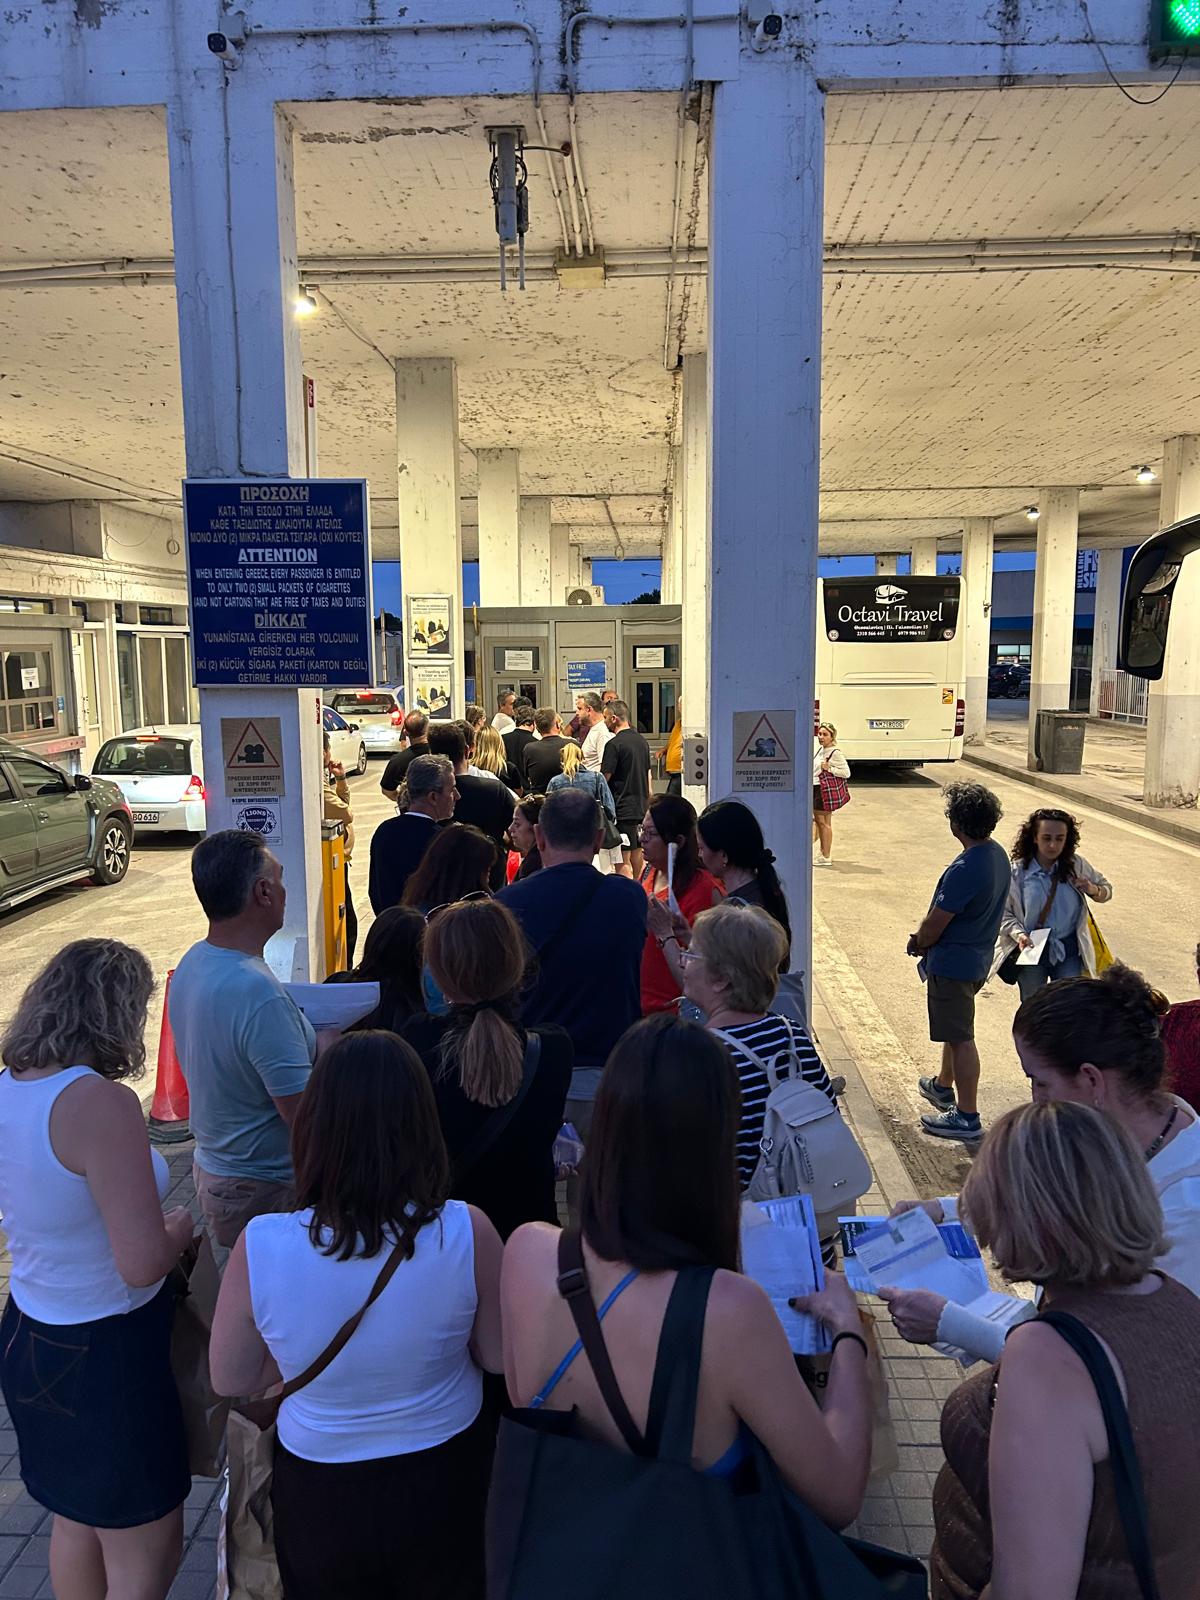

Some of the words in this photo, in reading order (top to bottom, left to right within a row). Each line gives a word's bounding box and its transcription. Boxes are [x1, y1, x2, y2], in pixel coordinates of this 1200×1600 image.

[240, 486, 309, 500] ΠΡΟΣΟΧΗ
[218, 506, 236, 516] ΚΑΤΑ
[240, 506, 253, 516] ΤΗΝ
[256, 506, 282, 516] ΕΙΣΟΔΟ
[285, 506, 303, 516] ΣΤΗΝ
[306, 506, 332, 516] ΕΛΛΑΔΑ
[210, 519, 230, 530] ΚΑΘΕ
[232, 519, 272, 530] ΤΑΞΙΔΙΩΤΗΣ
[275, 519, 312, 530] ΔΙΚΑΙΟΥΤΑΙ
[316, 519, 342, 530] ΑΤΕΛΩΣ
[190, 532, 212, 542] ΜΟΝΟ
[213, 532, 228, 542] ΔΥΟ
[229, 532, 238, 545] (2)
[240, 532, 261, 542] ΜΙΚΡΑ
[262, 532, 289, 542] ΠΑΚΕΤΑ
[290, 532, 318, 542] ΤΣΙΓΑΡΑ
[320, 532, 333, 544] (ΟΧΙ
[334, 532, 364, 544] ΚΟΥΤΕΣ)
[238, 548, 318, 561] ATTENTION
[195, 568, 212, 578] WHEN
[214, 568, 243, 578] ENTERING
[271, 568, 288, 578] EVERY
[290, 568, 324, 578] PASSENGER
[326, 568, 332, 578] IS
[334, 568, 361, 578] ENTITLED
[207, 582, 216, 593] TO
[218, 582, 232, 593] ONLY
[235, 582, 248, 593] TWO
[258, 582, 276, 593] SMALL
[278, 582, 304, 593] PACKETS
[306, 582, 314, 593] OF
[316, 582, 350, 593] CIGARETTES
[194, 597, 208, 607] (AND
[210, 597, 222, 607] NOT
[224, 597, 253, 607] CARTONS)
[254, 597, 268, 607] THAT
[270, 597, 282, 607] ARE
[285, 597, 300, 607] FREE
[301, 597, 309, 607] OF
[312, 597, 330, 607] TAXES
[331, 597, 343, 607] AND
[346, 597, 366, 607] DUTIES
[838, 604, 890, 622] Octavi
[894, 602, 943, 622] Travel
[254, 609, 306, 627] DİKKAT
[258, 631, 297, 643] GİRERKEN
[300, 633, 316, 643] HER
[318, 633, 359, 643] YOLCUNUN
[248, 645, 282, 656] VERGİSİZ
[286, 647, 316, 656] OLARAK
[196, 657, 206, 669] İKİ
[208, 660, 218, 671] (2)
[248, 658, 276, 669] SİGARA
[280, 658, 306, 669] PAKETİ
[308, 660, 340, 671] (KARTON
[344, 658, 368, 672] DEĞİL)
[238, 672, 270, 682] GETİRME
[274, 674, 296, 682] HAKKI
[300, 674, 328, 682] VARDIR
